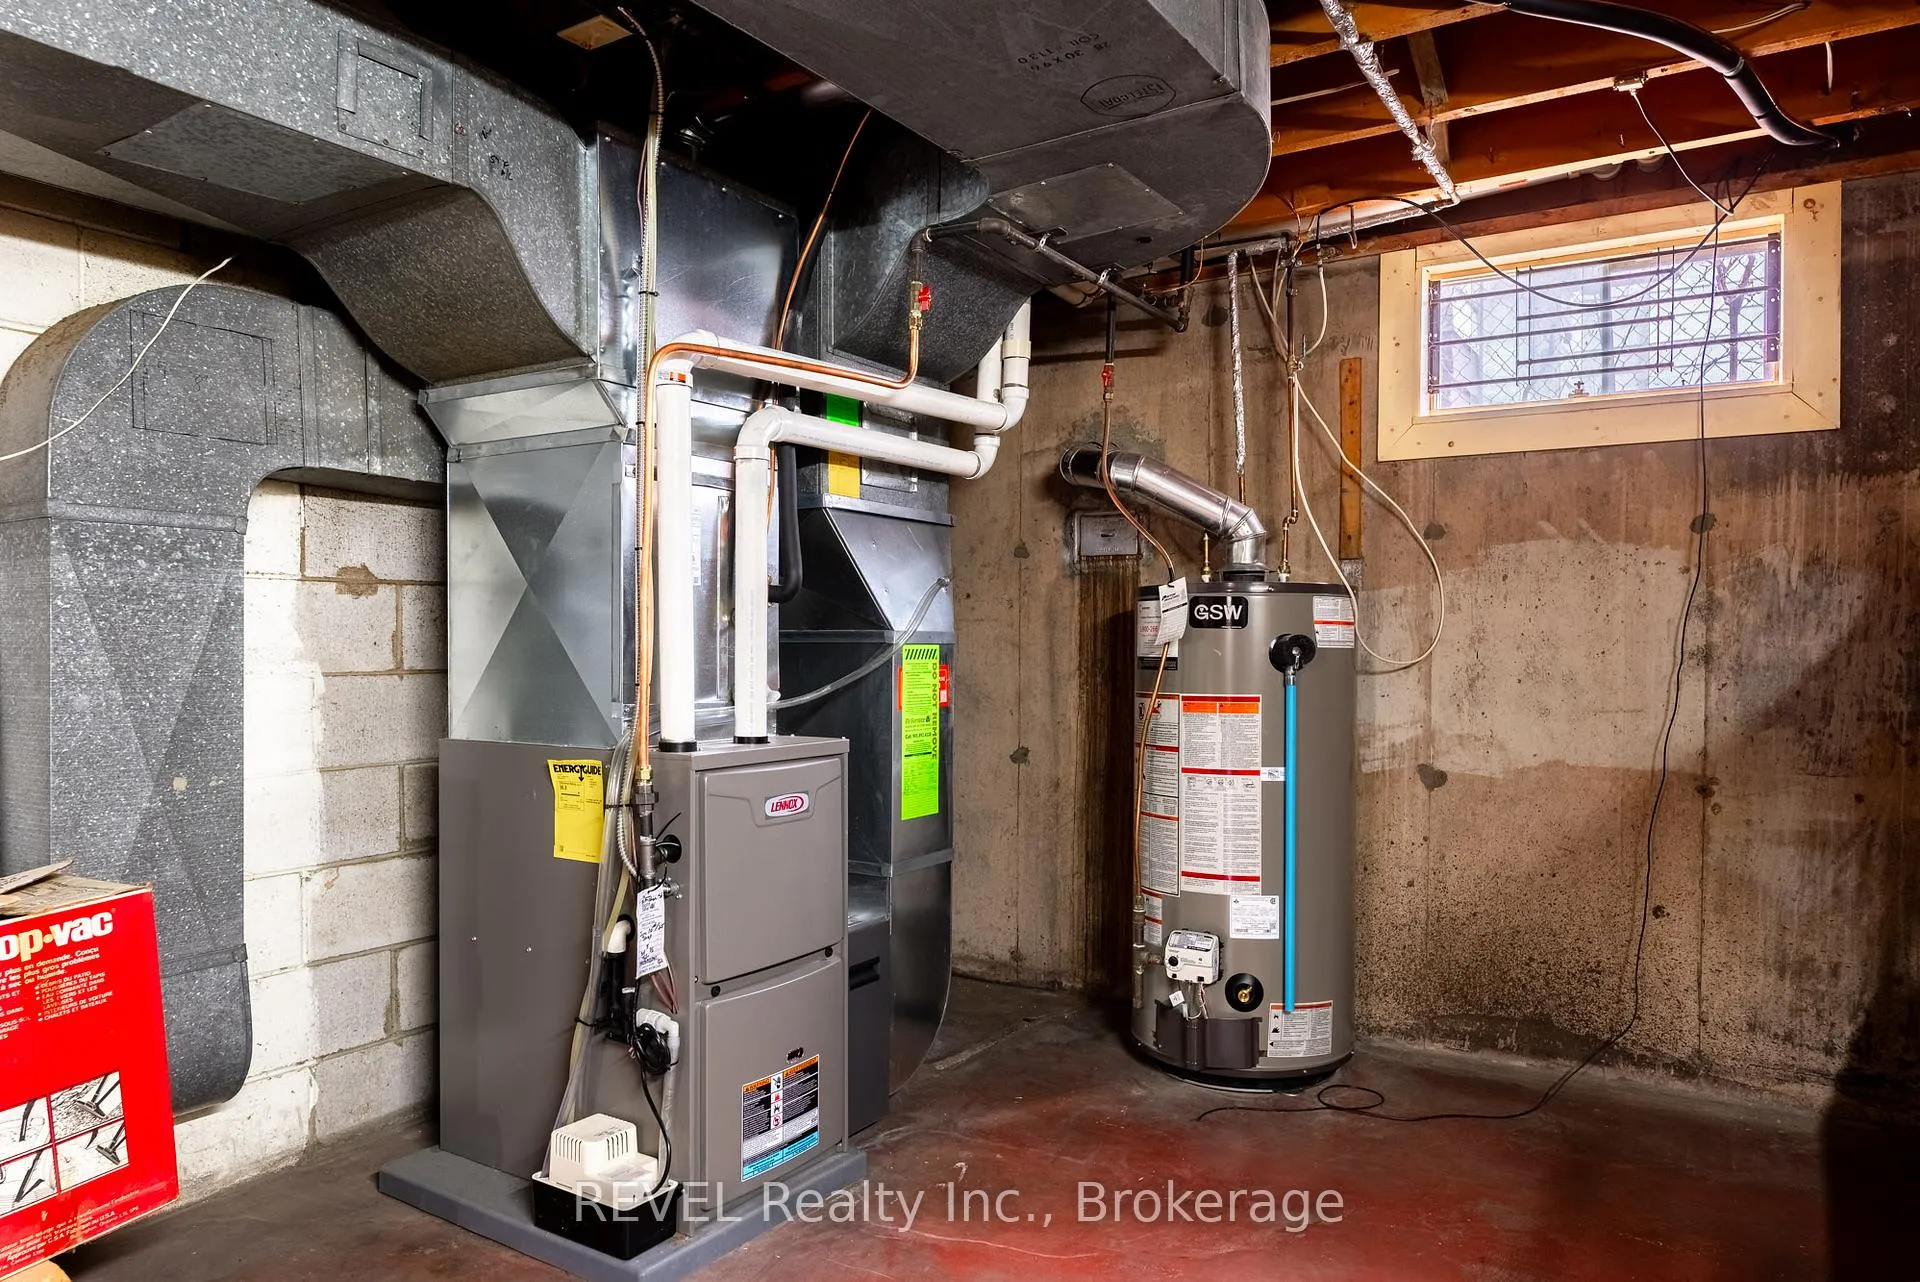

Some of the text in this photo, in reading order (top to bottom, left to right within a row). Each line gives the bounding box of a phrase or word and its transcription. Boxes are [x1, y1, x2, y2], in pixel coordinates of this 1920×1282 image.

[1194, 604, 1243, 620] GSW
[932, 662, 938, 680] DO
[770, 798, 798, 813] LENNOX
